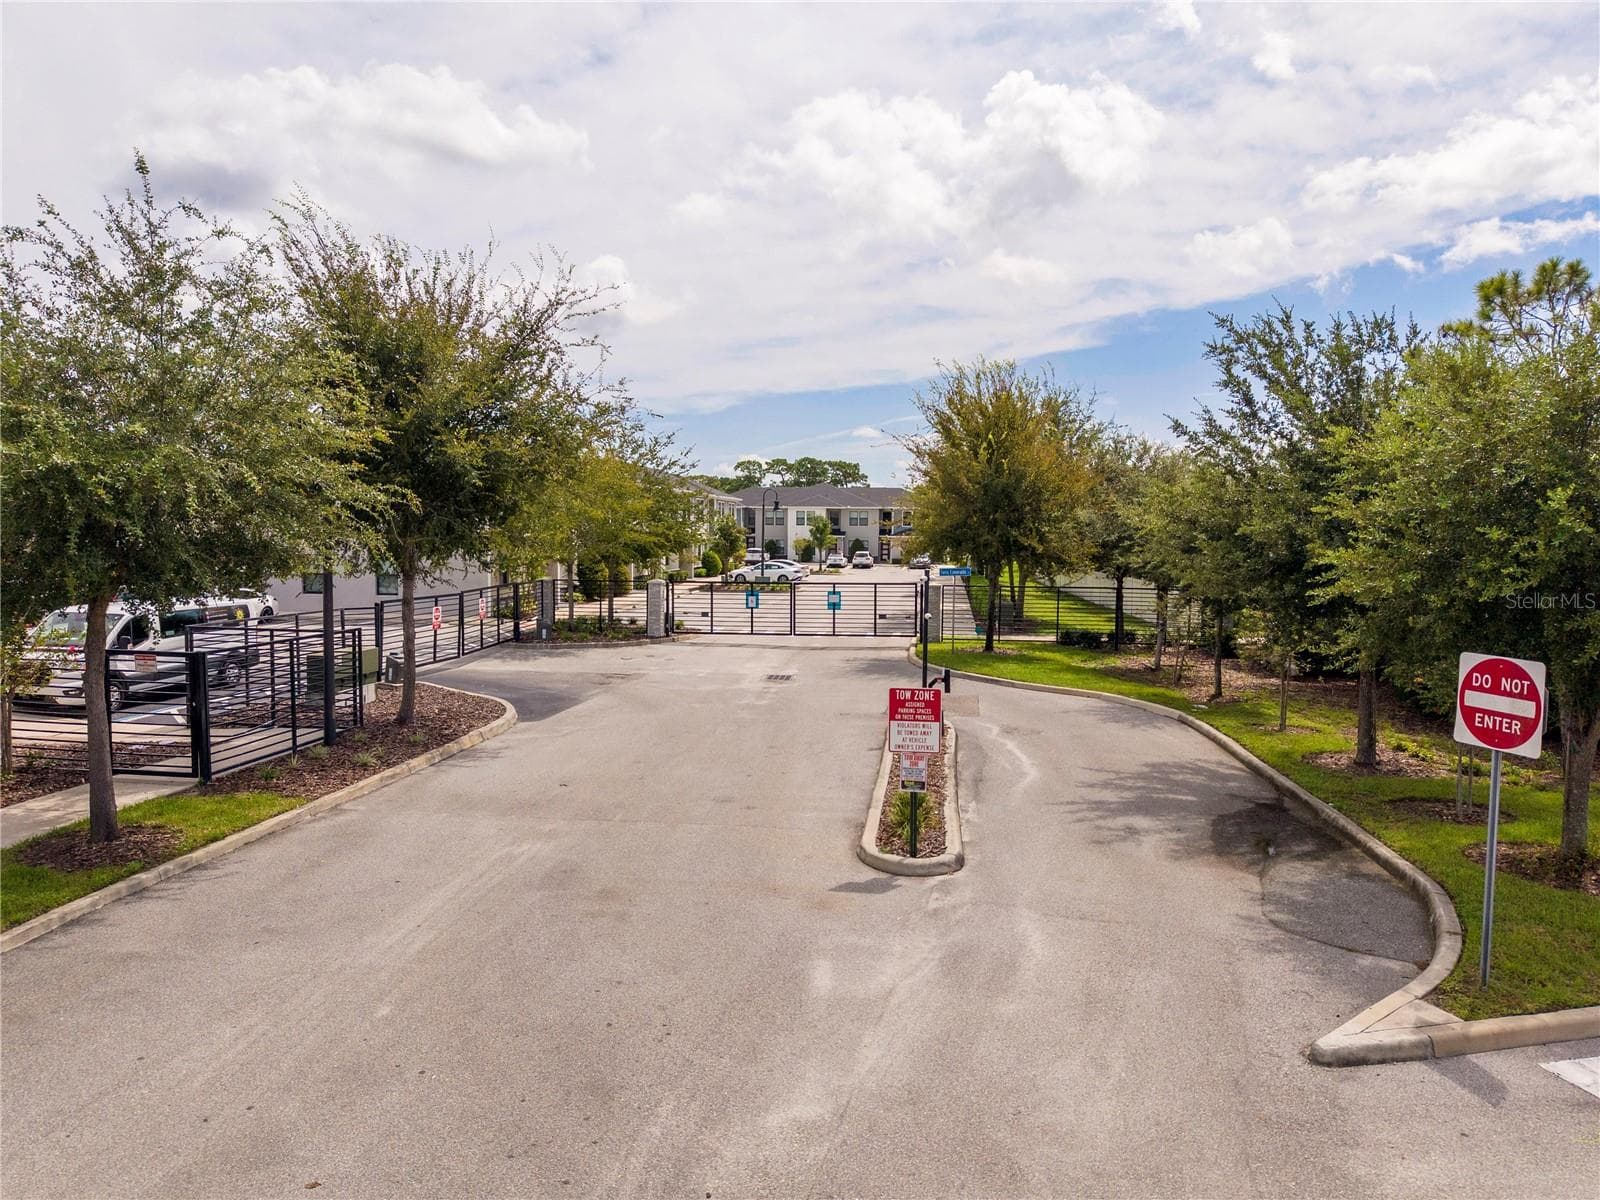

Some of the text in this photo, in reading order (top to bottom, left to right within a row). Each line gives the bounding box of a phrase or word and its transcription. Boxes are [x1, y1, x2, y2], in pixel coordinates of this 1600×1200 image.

[1472, 672, 1531, 695] DO NOT
[896, 690, 935, 701] TOW ZONE
[1474, 712, 1521, 735] ENTER
